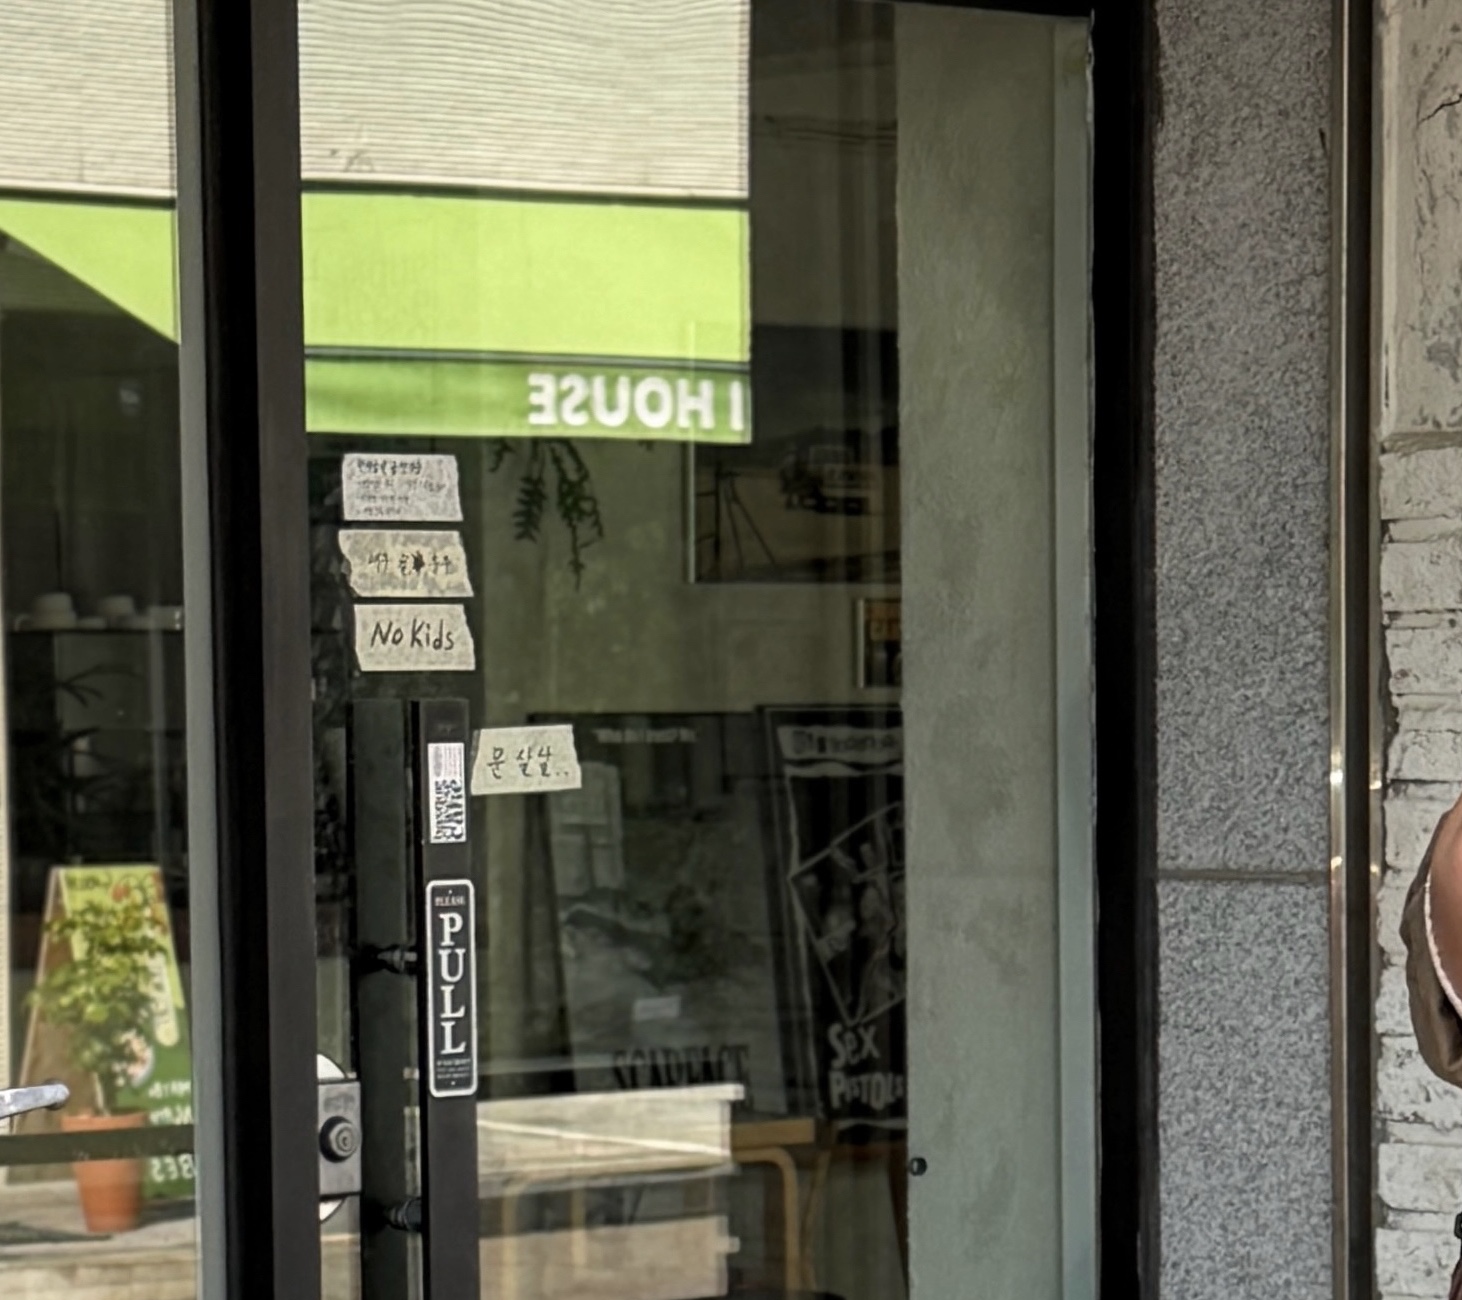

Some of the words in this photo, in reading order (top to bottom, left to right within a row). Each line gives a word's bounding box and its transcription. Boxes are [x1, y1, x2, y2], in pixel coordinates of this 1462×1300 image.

[370, 621, 404, 648] No
[410, 618, 455, 650] Kids
[486, 746, 505, 780] 문
[438, 911, 467, 1055] PULL
